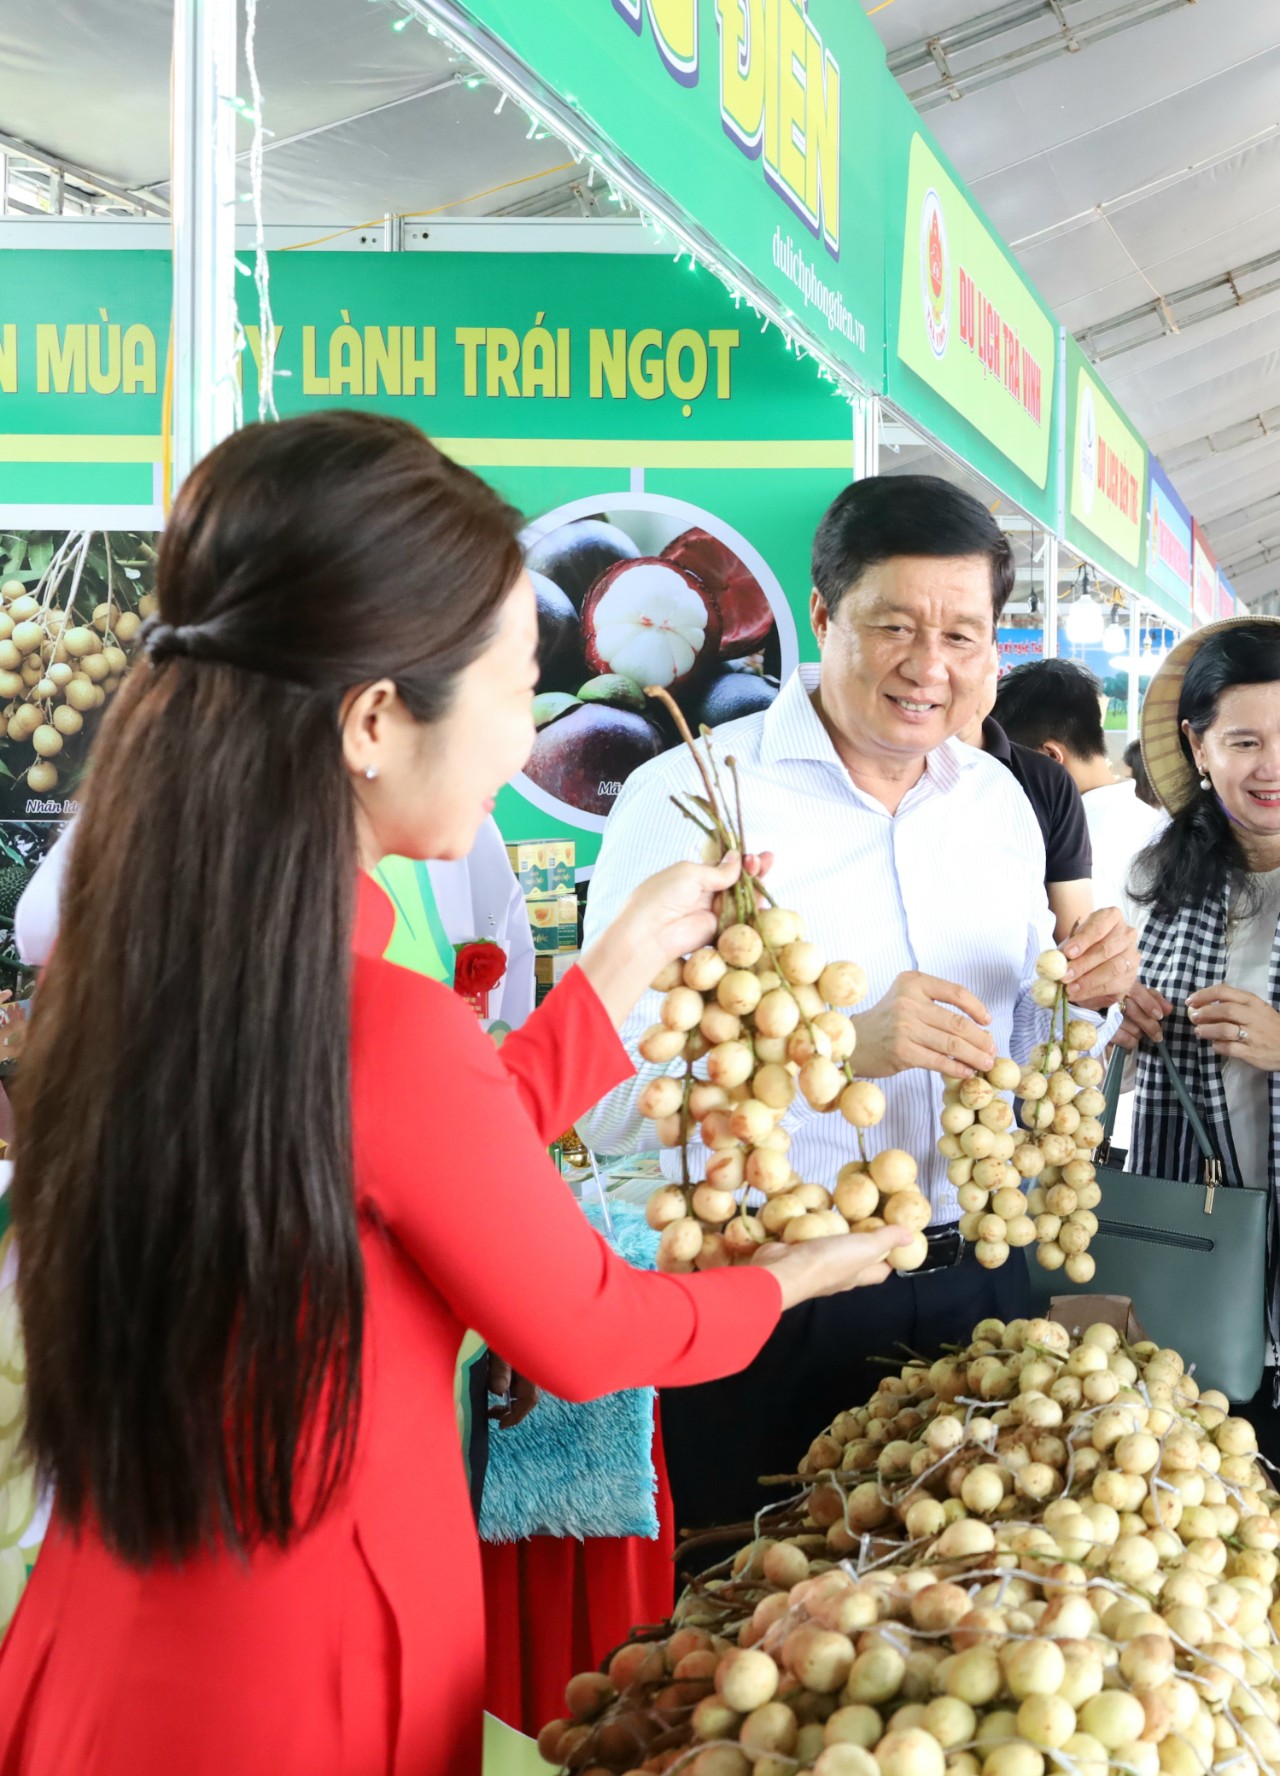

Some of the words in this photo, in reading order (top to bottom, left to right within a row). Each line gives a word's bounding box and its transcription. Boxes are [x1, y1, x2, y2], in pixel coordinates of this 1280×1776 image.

[772, 225, 866, 353] dulichphongdien.vn
[36, 307, 157, 395] MÙA
[303, 309, 437, 397] LÀNH
[455, 311, 571, 398] TRÁI
[589, 328, 741, 418] NGỌT
[959, 265, 975, 353] DU
[978, 288, 1001, 383] LỊCH
[1003, 321, 1021, 405] TRÀ
[1022, 345, 1042, 428] VINH
[25, 799, 62, 813] Nhãn
[598, 781, 623, 795] Mă
